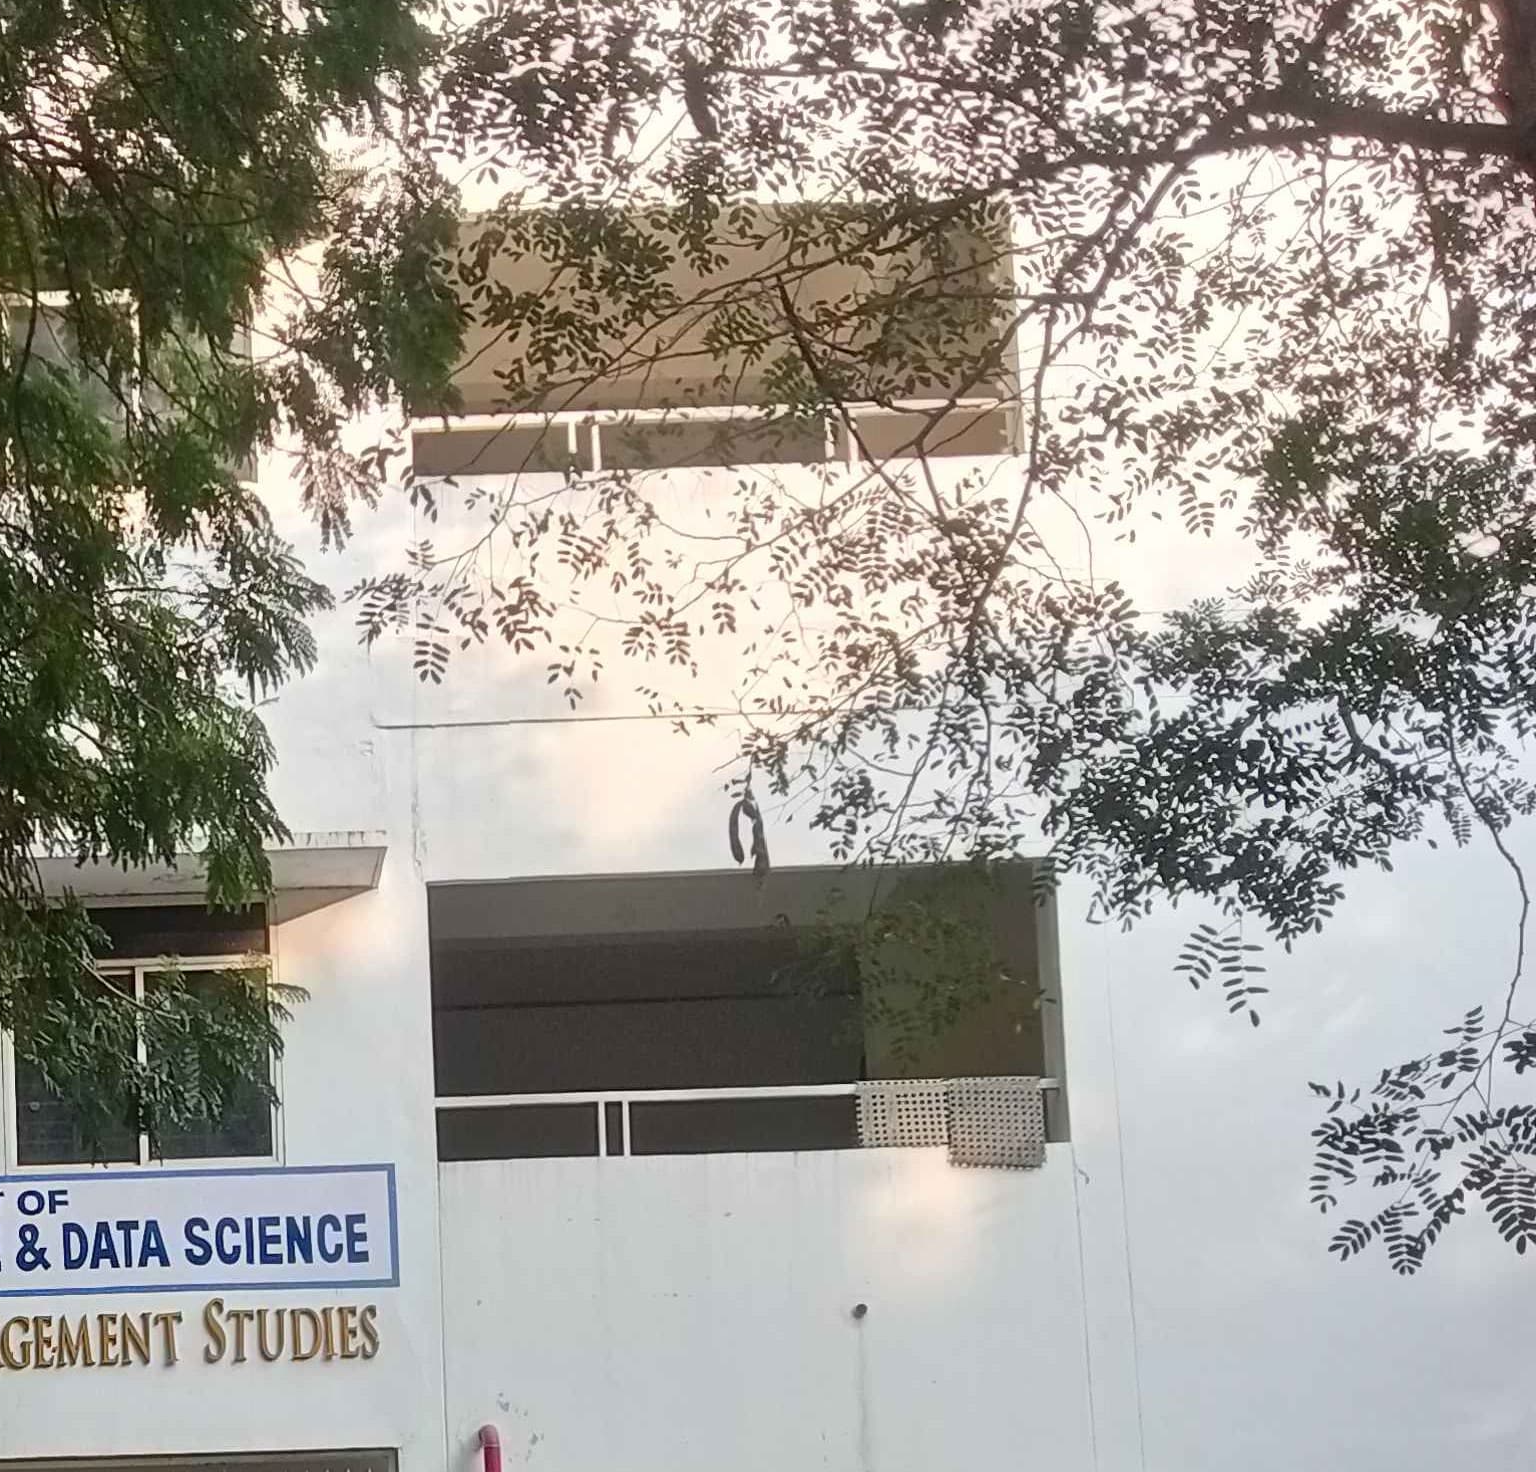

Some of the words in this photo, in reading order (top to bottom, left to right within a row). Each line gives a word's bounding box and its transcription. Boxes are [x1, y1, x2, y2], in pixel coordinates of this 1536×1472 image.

[17, 1189, 68, 1216] OF
[16, 1223, 51, 1271] &
[63, 1220, 170, 1270] DATA
[184, 1213, 370, 1266] SCIENCE
